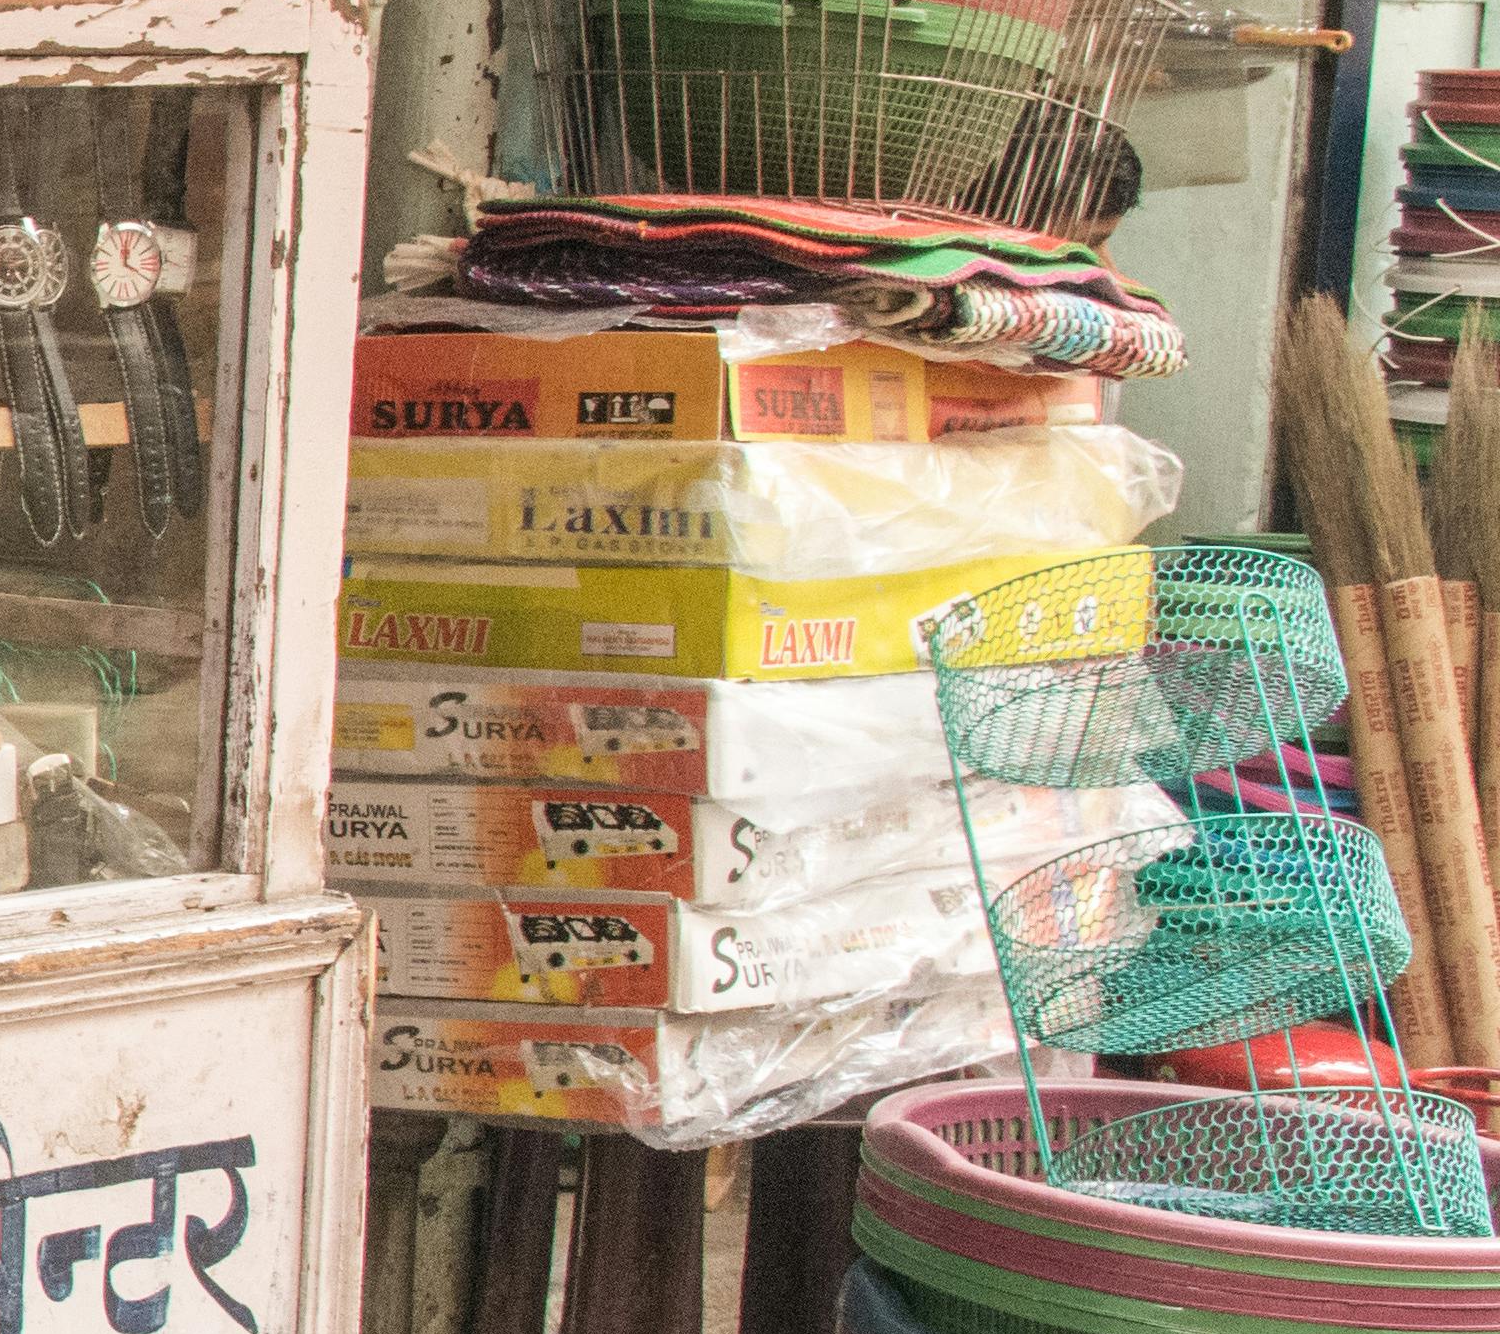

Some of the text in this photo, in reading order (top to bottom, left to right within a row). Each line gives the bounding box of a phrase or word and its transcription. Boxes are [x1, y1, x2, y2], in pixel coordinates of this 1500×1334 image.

[371, 399, 533, 432] SURYA
[754, 387, 842, 422] SURYA
[520, 487, 714, 540] Laxmi
[347, 611, 491, 655] LAXMI
[761, 618, 856, 667] LAXMI
[426, 691, 548, 743] SURYA
[329, 803, 409, 819] PRAJWAL
[1369, 770, 1396, 835] Thakral
[328, 820, 408, 840] URYA
[380, 1025, 496, 1077] SURYA
